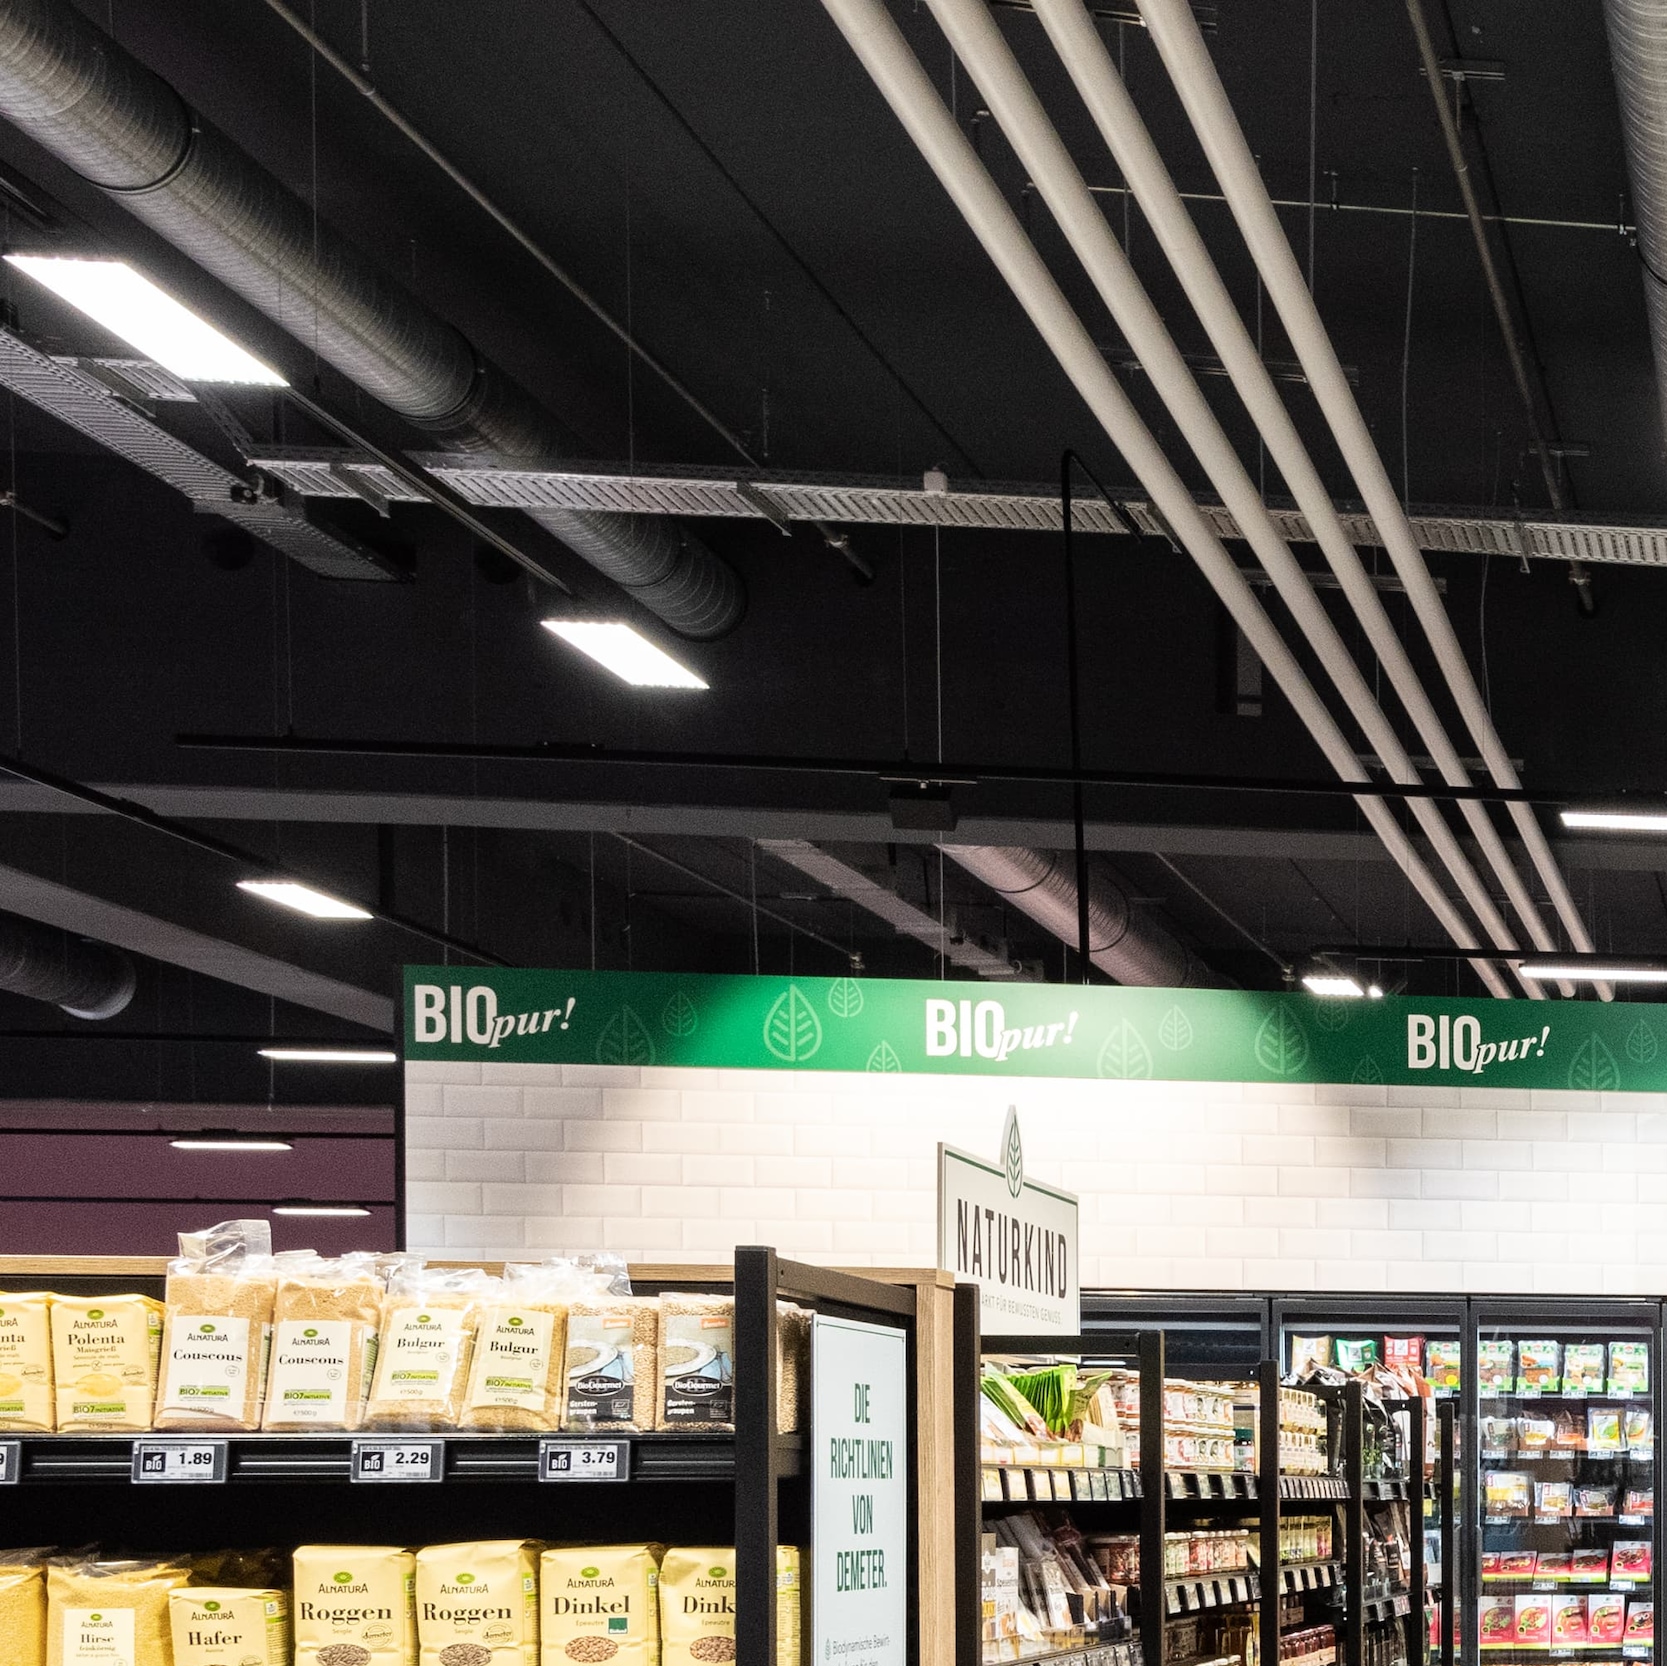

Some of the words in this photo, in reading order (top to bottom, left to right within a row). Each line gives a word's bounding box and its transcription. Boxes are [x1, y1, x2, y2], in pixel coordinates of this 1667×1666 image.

[957, 1198, 1067, 1299] NATURKIND
[73, 1319, 118, 1329] ALNATURA
[67, 1332, 126, 1345] Polenta
[187, 1333, 228, 1343] ALNATURA
[397, 1337, 446, 1350] Bulgur
[173, 1349, 243, 1363] Couscous
[576, 1380, 623, 1392] BioGourmet
[854, 1383, 870, 1424] DIE
[178, 1452, 212, 1466] 1.89
[395, 1452, 429, 1465] 2.29
[582, 1451, 615, 1464] 3.79
[831, 1438, 893, 1479] RICHTLINIEN
[852, 1495, 873, 1534] VON
[837, 1549, 887, 1592] DEMETER.
[553, 1596, 631, 1615] Dinkel
[300, 1602, 393, 1625] Roggen
[80, 1634, 115, 1644] Hirse
[187, 1631, 243, 1646] Hafer
